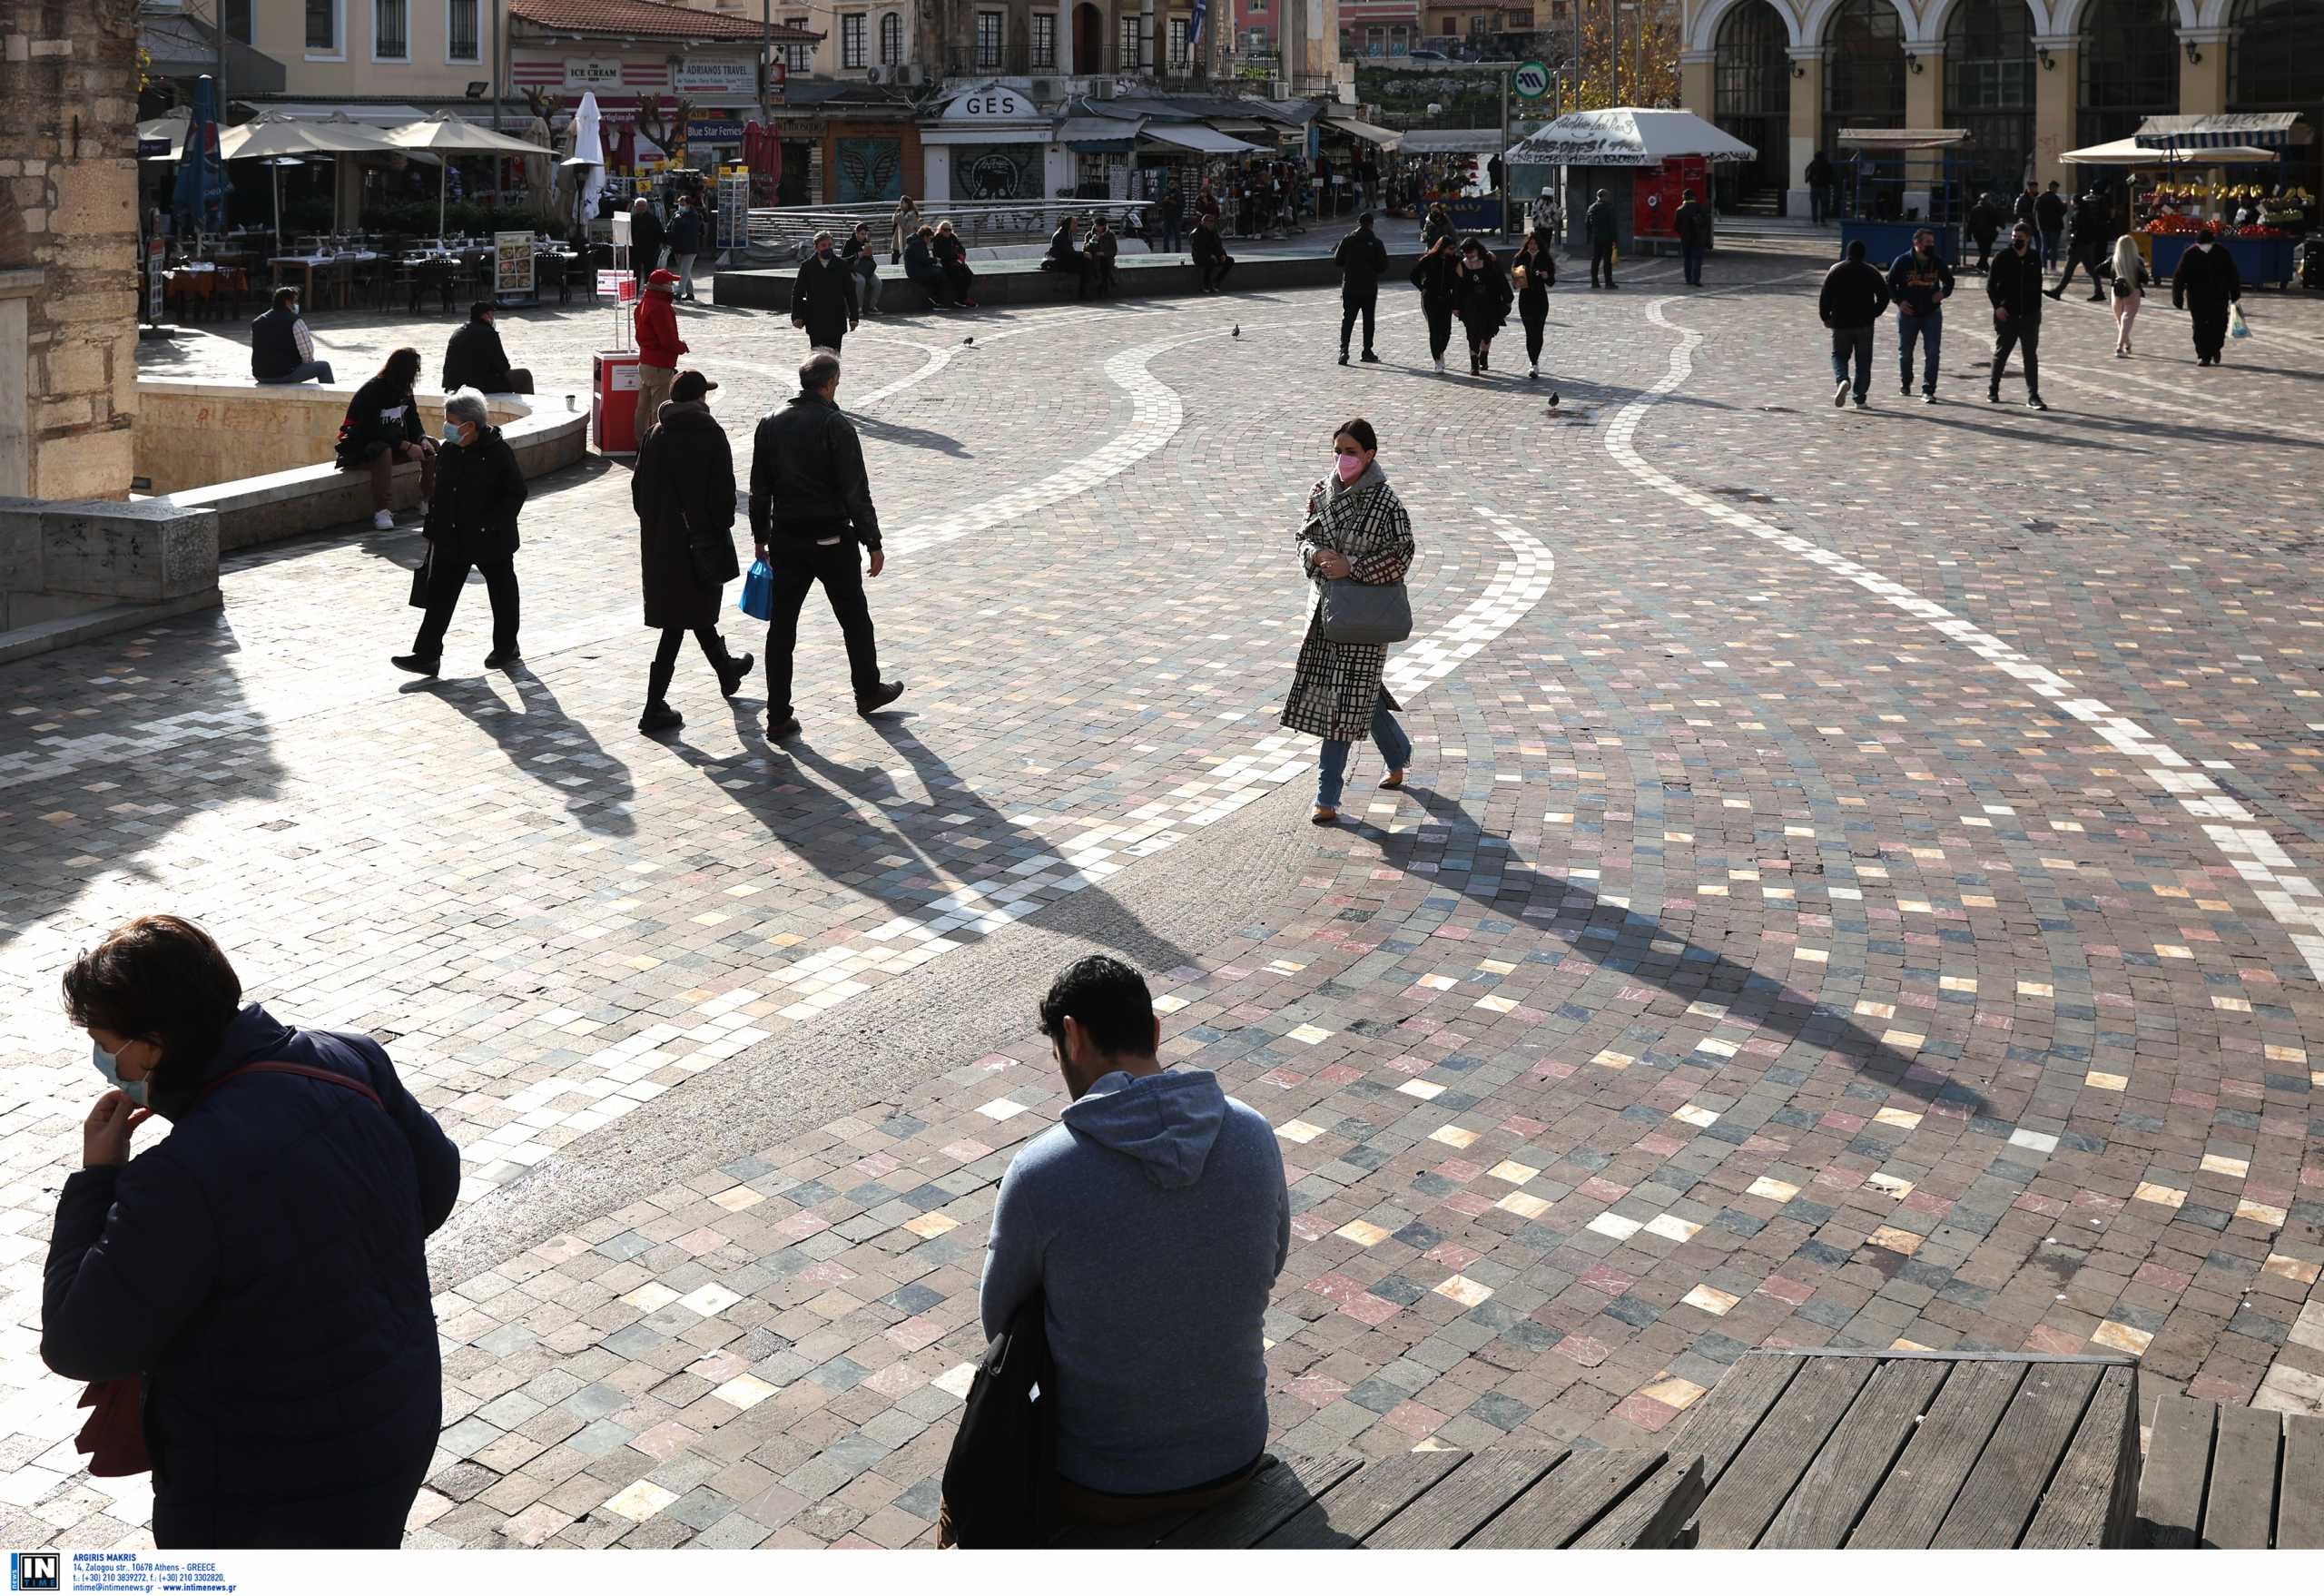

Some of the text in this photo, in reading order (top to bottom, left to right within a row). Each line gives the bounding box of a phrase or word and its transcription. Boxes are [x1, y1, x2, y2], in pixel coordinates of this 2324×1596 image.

[570, 69, 617, 77] ICE CREAM
[687, 65, 747, 75] ADRIANOS TRAVEL
[967, 97, 1014, 114] GES
[687, 125, 743, 137] Blue Star Ferries
